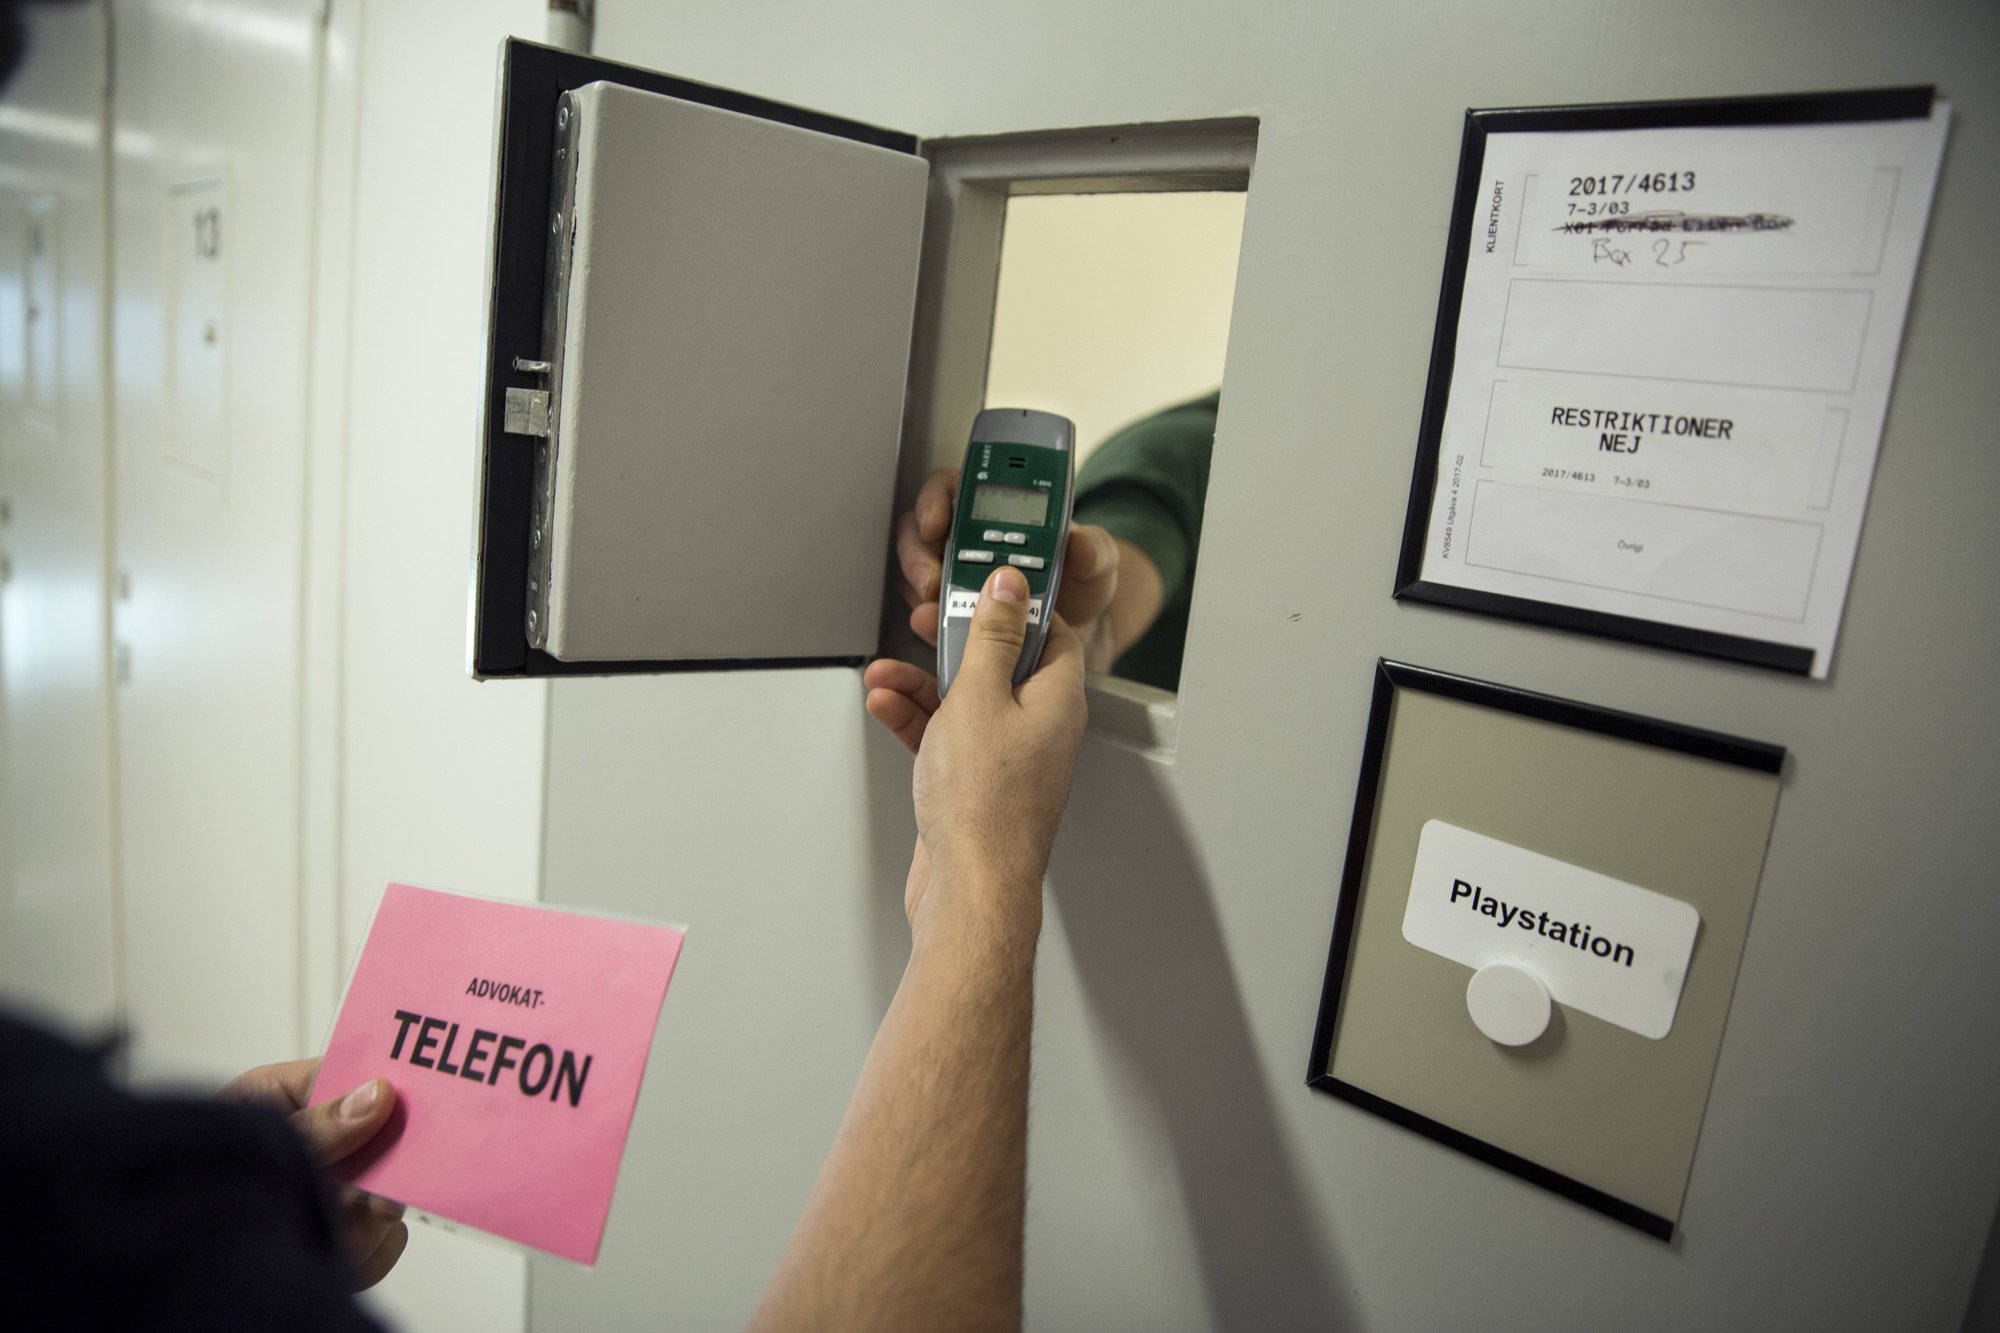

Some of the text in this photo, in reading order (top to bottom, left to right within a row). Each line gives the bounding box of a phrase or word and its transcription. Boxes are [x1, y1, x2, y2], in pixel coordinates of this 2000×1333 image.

[1568, 171, 1697, 196] 2017/4613
[1486, 180, 1504, 253] KLIENTKORT
[1567, 201, 1630, 216] 7-3/03
[1652, 239, 1708, 267] 25
[1551, 406, 1733, 440] RESTRIKTIONER
[1599, 432, 1641, 454] NEJ
[1453, 454, 1464, 488] 2017-02
[1542, 467, 1650, 489] 2017/4613 7-3/03
[964, 551, 988, 560] MENU
[1019, 556, 1032, 564] OK
[952, 600, 967, 608] 8:4
[1028, 607, 1039, 617] 4)
[1450, 878, 1635, 967] Playstation
[465, 977, 546, 1009] ADVOKAT-
[389, 1009, 593, 1108] TELEFON
